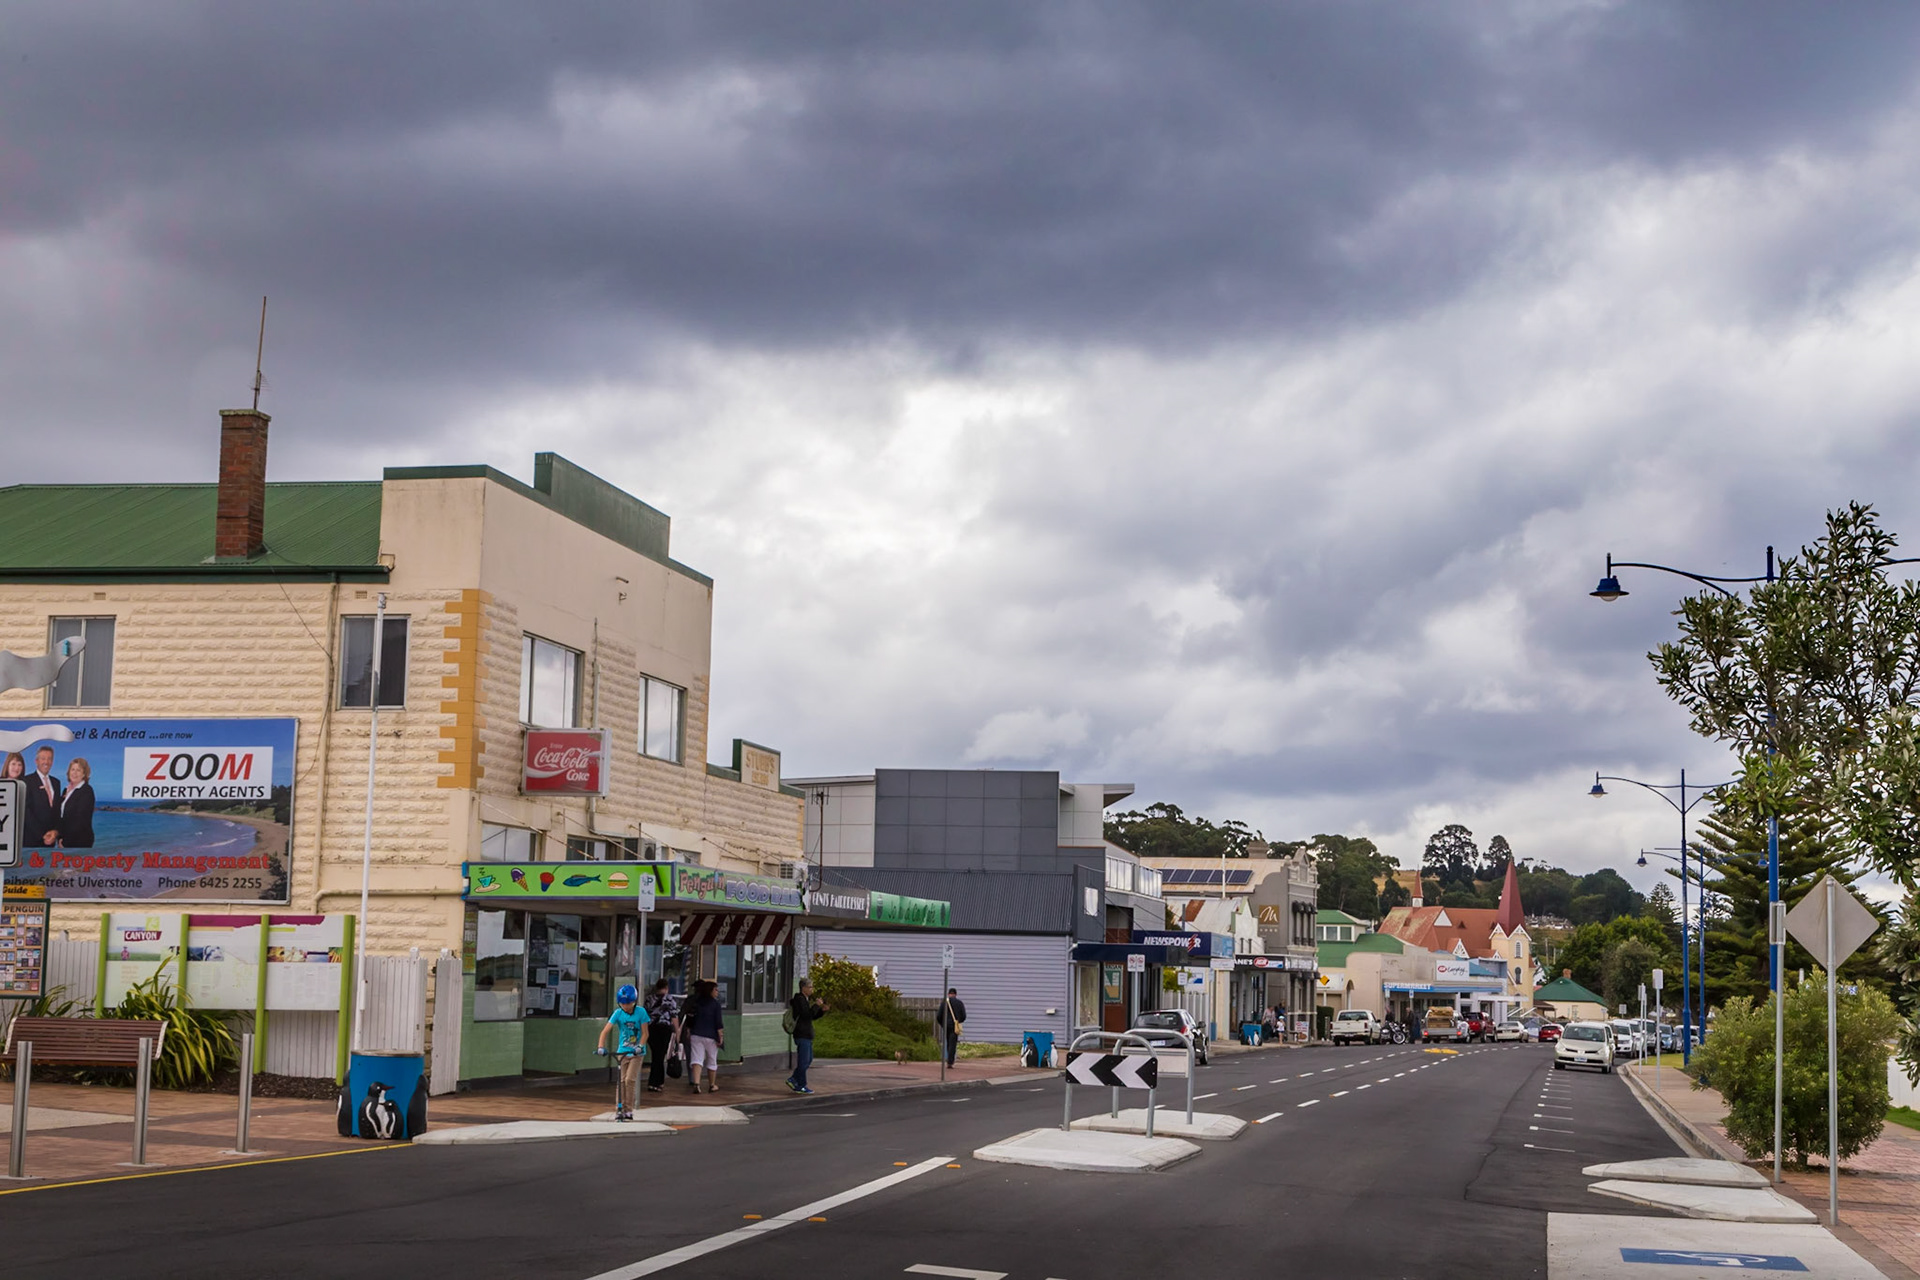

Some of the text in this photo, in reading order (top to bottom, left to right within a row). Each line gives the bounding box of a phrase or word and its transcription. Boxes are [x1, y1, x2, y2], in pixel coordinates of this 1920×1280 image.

[73, 728, 86, 739] el
[89, 728, 98, 739] &
[102, 728, 146, 739] Andrea
[534, 747, 591, 768] Coca-Cola
[146, 753, 253, 780] ZOOM
[566, 769, 590, 781] Coke
[132, 786, 265, 797] PROPERTY AGENTS
[29, 851, 270, 872] & Property Management
[4, 876, 262, 888] eibey Street Ulverstone Phone 6425 2255
[679, 869, 725, 900] Penguin
[725, 880, 770, 904] FOOD
[4, 905, 45, 913] PENGUIN
[125, 931, 157, 940] CANYON
